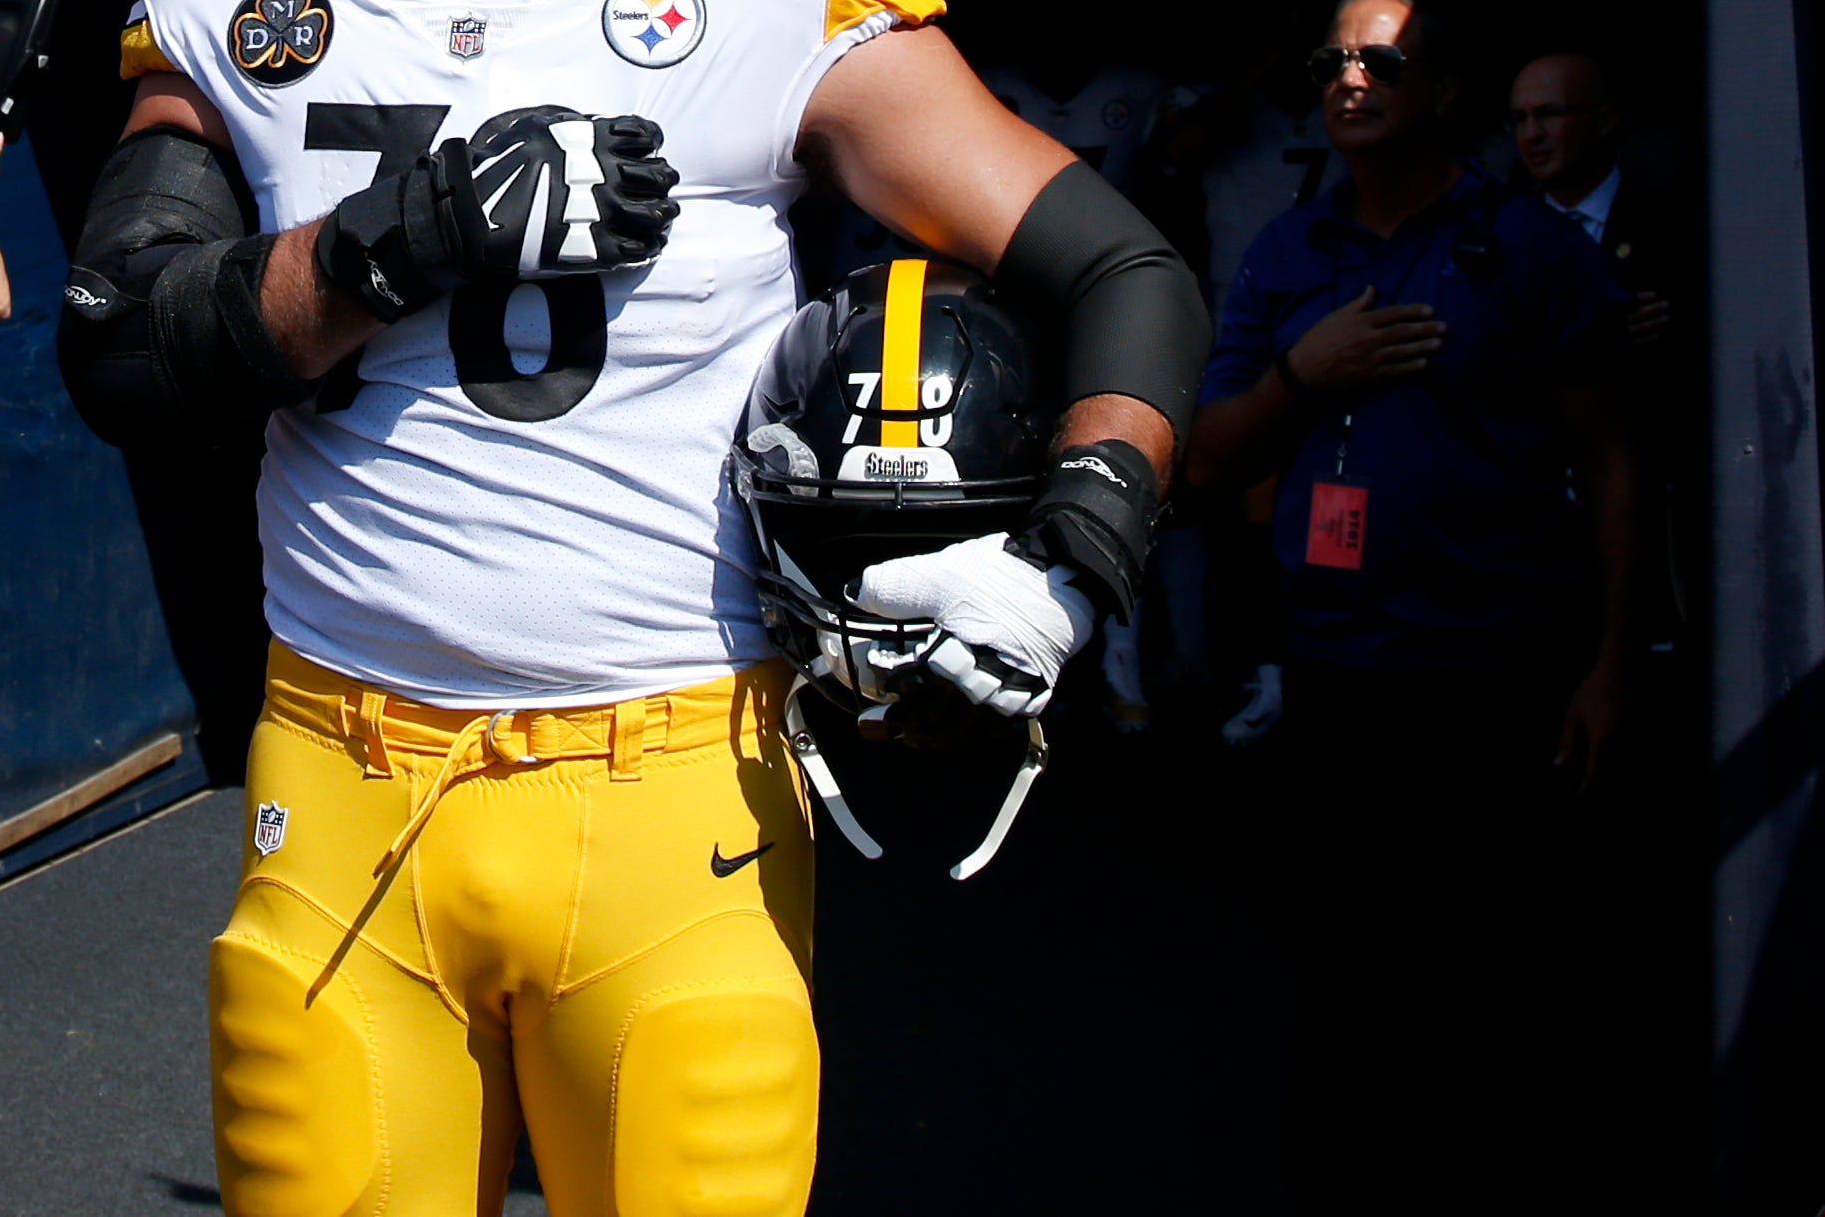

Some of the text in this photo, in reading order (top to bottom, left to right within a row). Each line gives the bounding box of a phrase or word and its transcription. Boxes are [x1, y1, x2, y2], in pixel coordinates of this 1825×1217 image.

[270, 0, 295, 19] M
[612, 10, 649, 22] Steelers
[245, 25, 314, 50] D R
[452, 34, 481, 52] NFL
[842, 372, 954, 447] 78
[864, 451, 930, 480] Steelers
[259, 824, 279, 846] NFL
